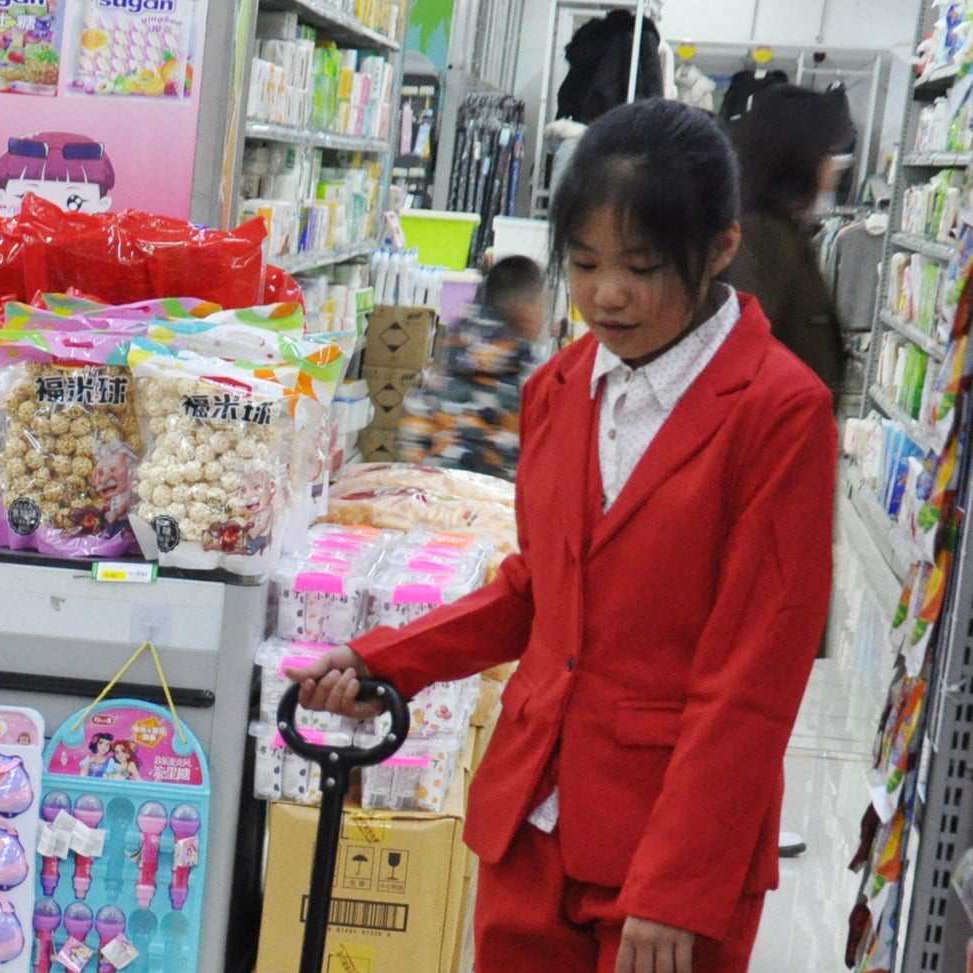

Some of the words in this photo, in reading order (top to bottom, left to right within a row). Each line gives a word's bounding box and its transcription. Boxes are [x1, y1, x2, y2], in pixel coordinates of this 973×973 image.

[35, 375, 128, 405] 福米球
[182, 394, 273, 425] 福米球
